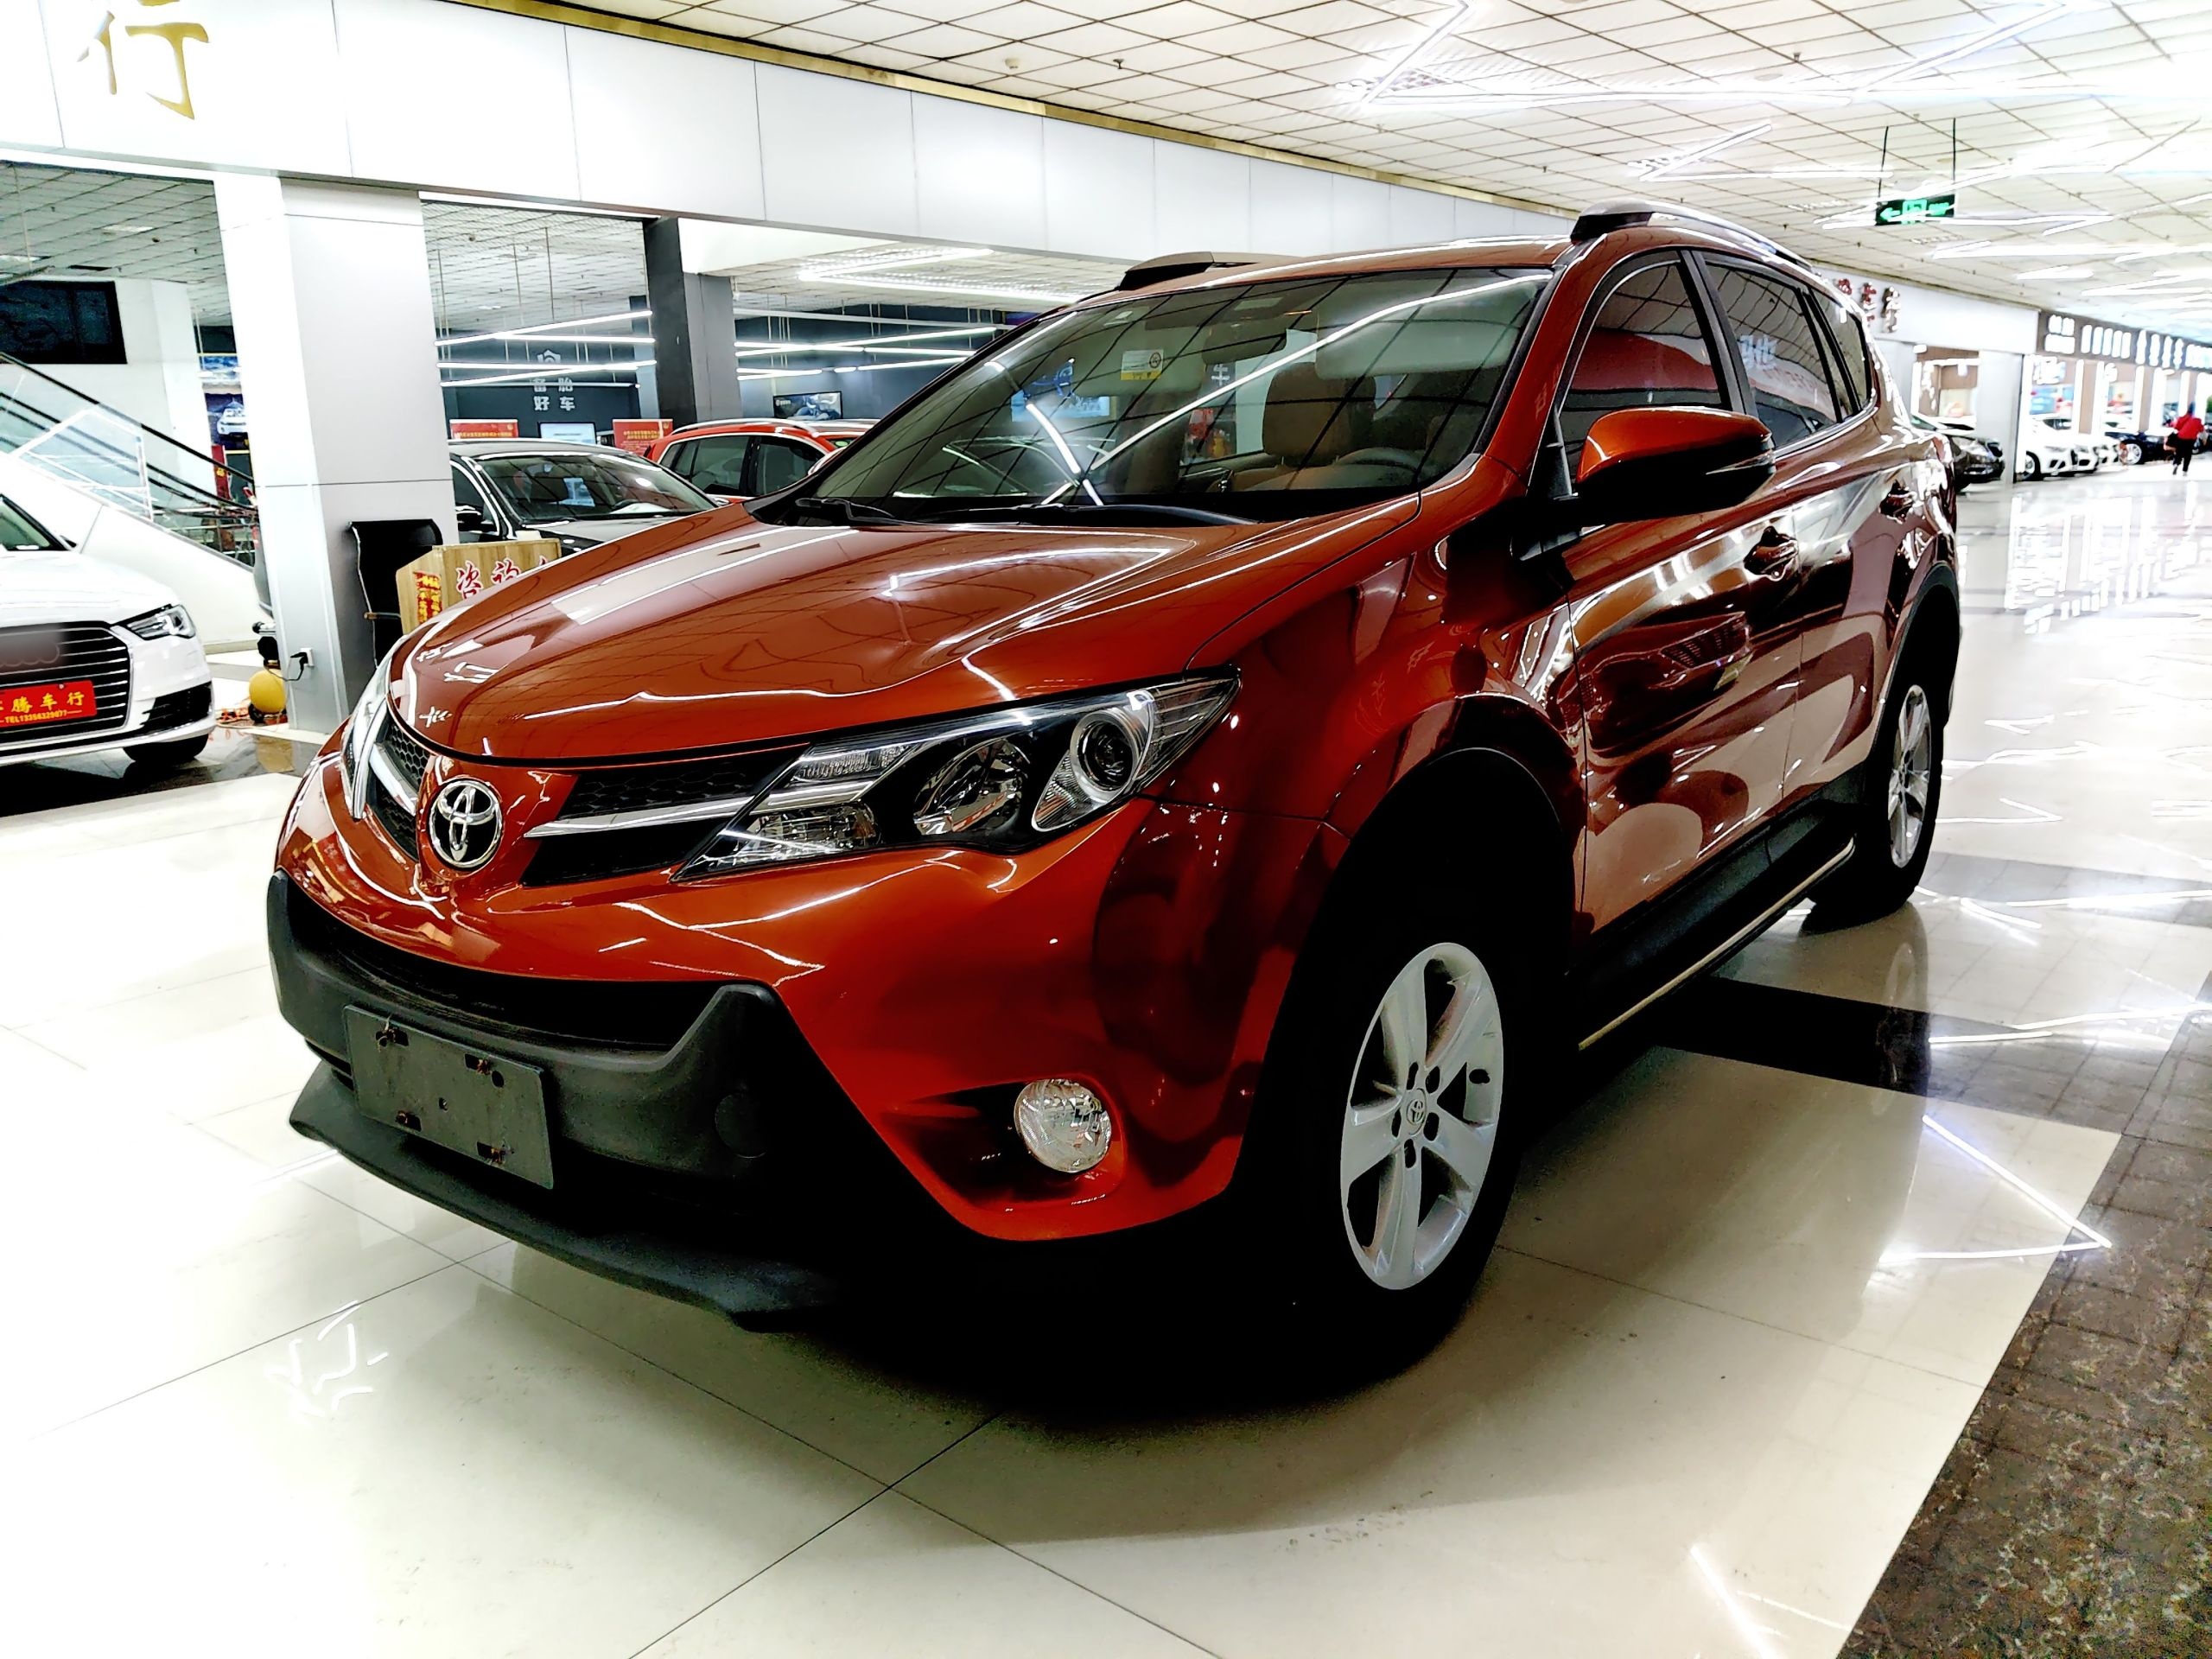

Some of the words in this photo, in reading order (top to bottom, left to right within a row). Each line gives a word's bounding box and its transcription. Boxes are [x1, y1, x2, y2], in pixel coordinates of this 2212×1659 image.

[76, 0, 209, 120] 行
[533, 396, 575, 411] 好车
[0, 691, 85, 714] 腾车行
